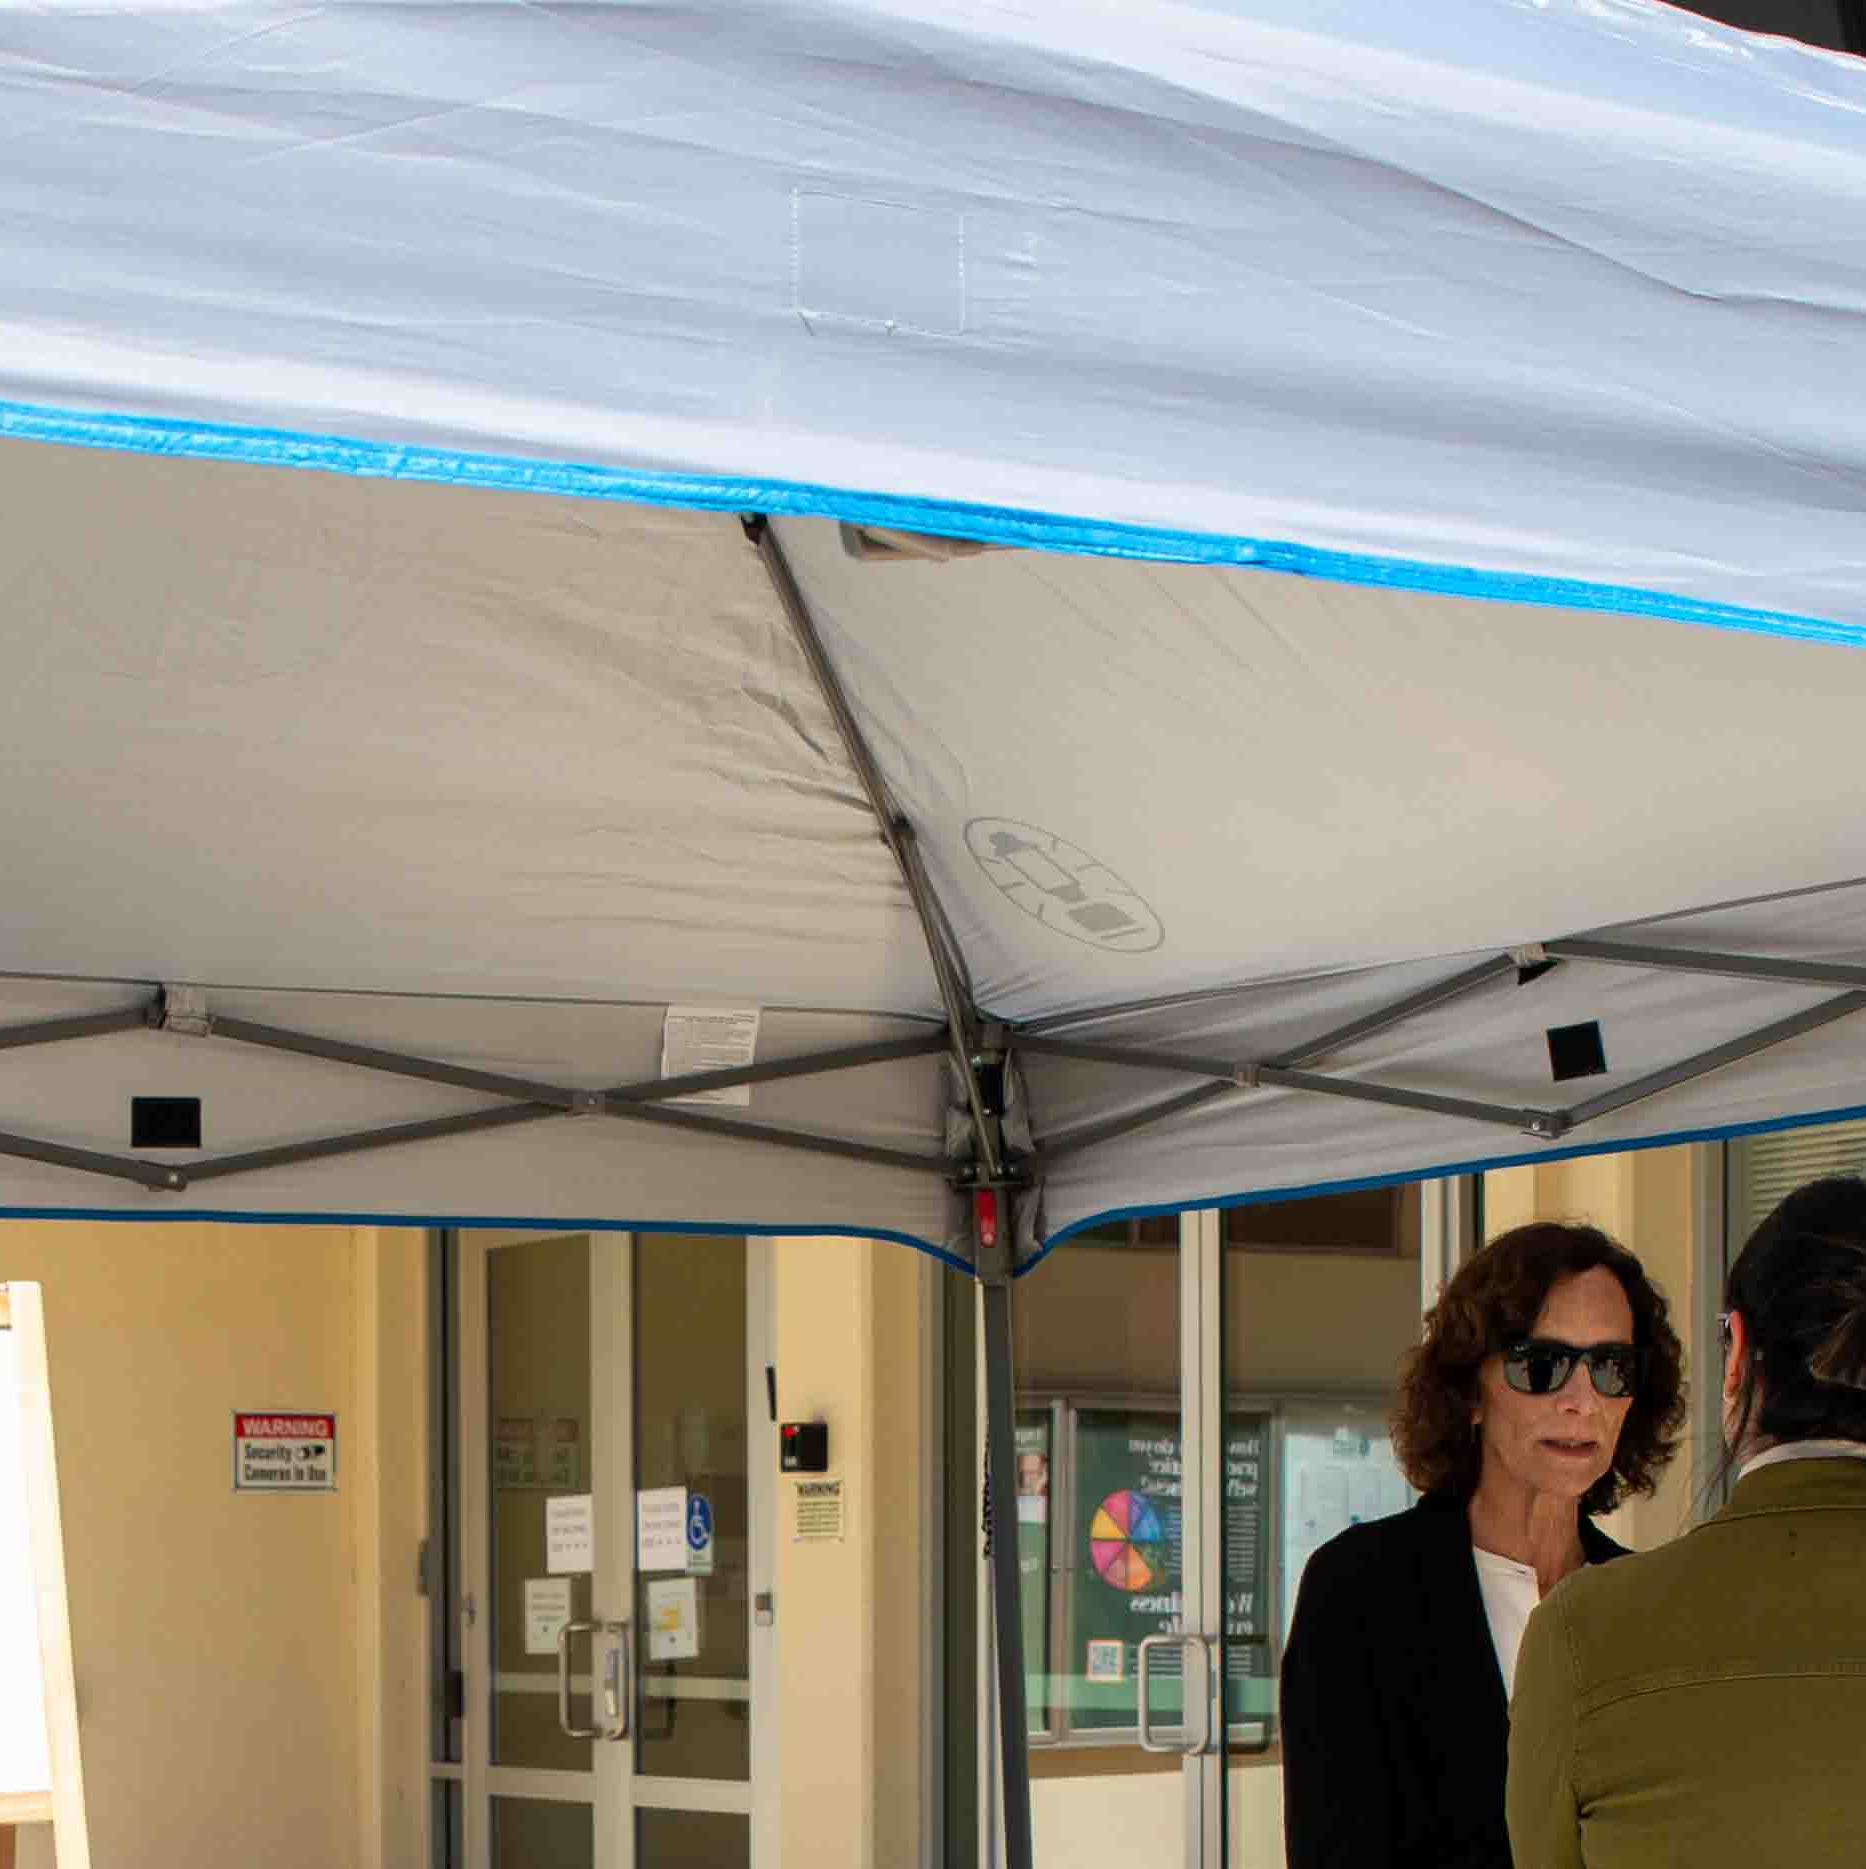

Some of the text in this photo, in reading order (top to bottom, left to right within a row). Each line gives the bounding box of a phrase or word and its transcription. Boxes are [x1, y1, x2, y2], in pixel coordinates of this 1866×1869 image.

[243, 1418, 328, 1437] WARNING
[244, 1443, 293, 1463] Security
[244, 1464, 293, 1481] Cameras
